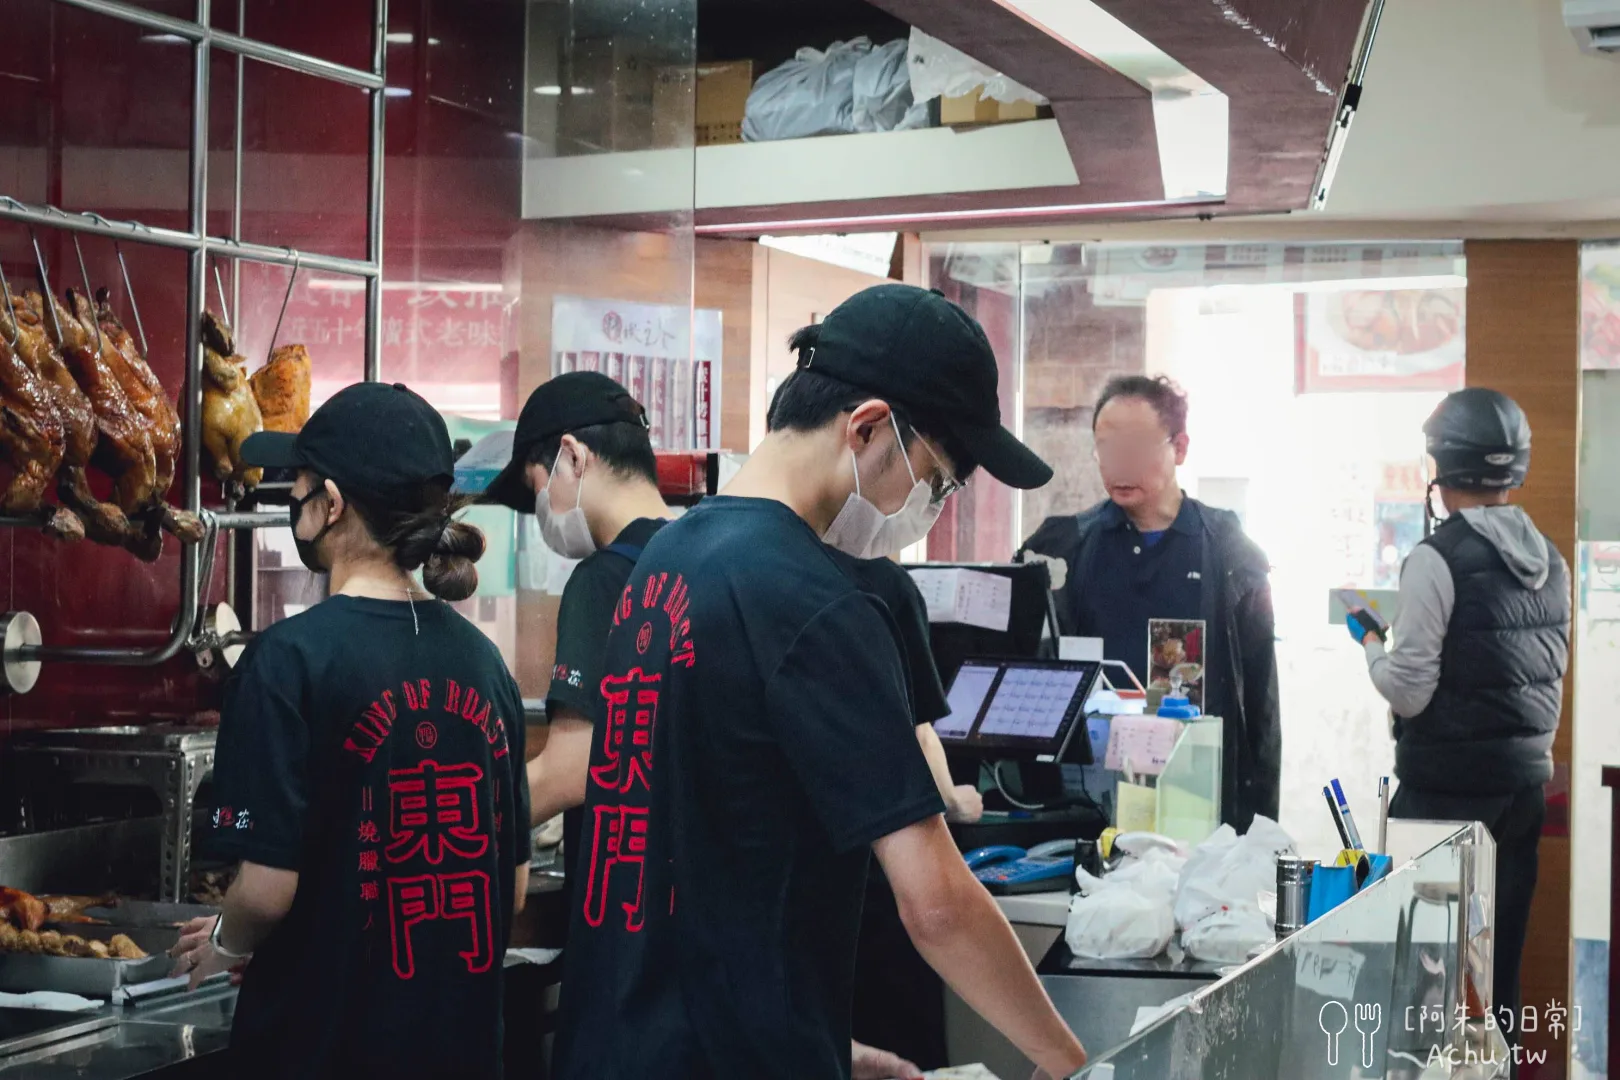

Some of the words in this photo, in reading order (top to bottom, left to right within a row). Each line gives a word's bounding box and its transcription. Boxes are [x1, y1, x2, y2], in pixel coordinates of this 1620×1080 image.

[343, 689, 397, 763] KING
[402, 679, 431, 711] OF
[444, 679, 509, 760] ROAST
[384, 759, 494, 980] 東門
